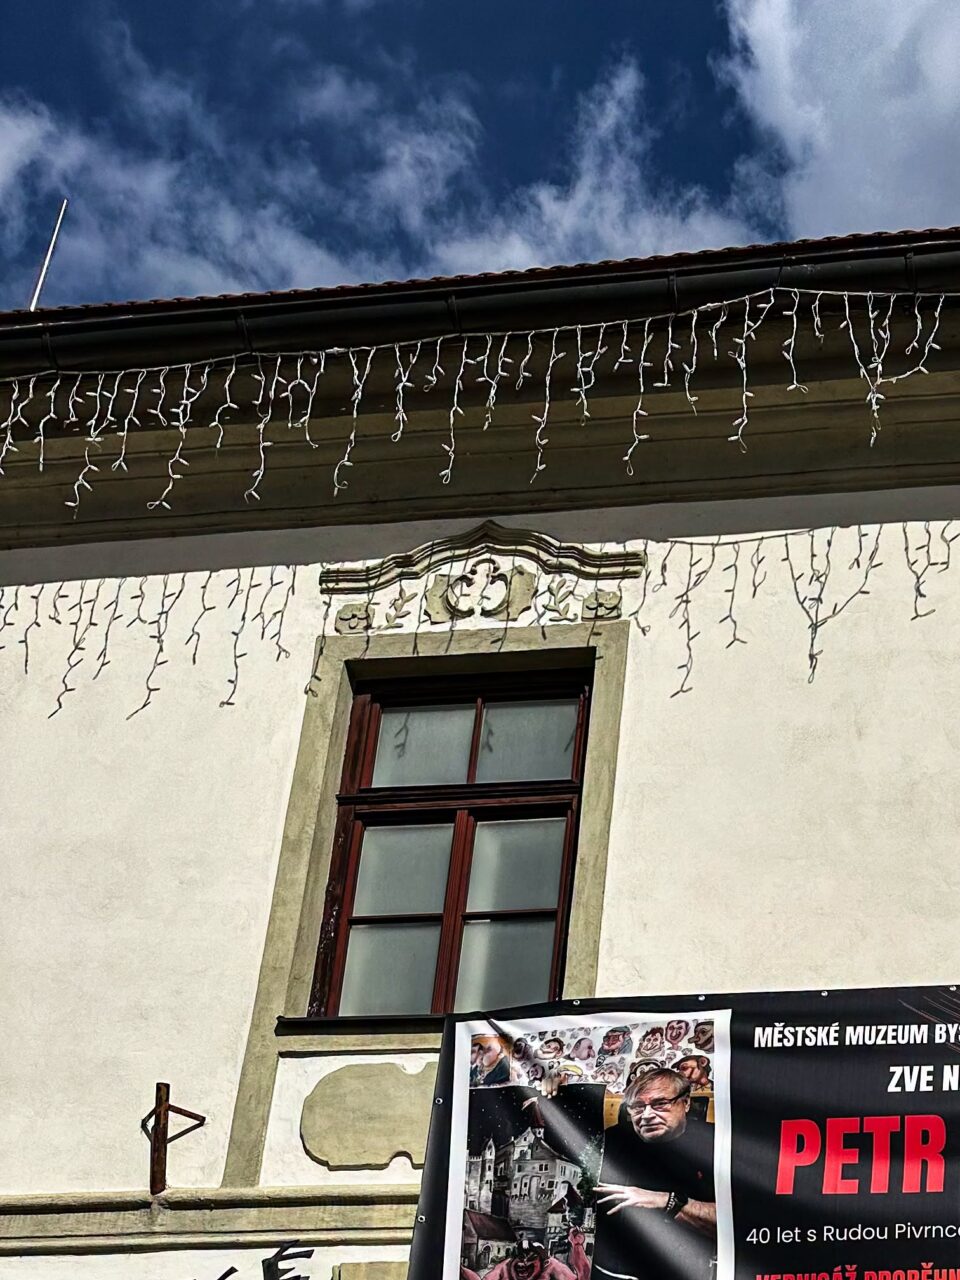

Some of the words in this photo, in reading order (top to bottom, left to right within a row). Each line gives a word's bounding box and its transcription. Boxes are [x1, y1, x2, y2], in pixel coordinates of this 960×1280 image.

[754, 1023, 839, 1048] MĚSTSKÉ
[845, 1023, 929, 1046] MUZEUM
[888, 1064, 934, 1093] ZVE
[775, 1114, 946, 1194] PETR
[746, 1227, 770, 1245] 40
[776, 1224, 802, 1244] let
[806, 1228, 817, 1243] s
[823, 1224, 888, 1242] Rudou
